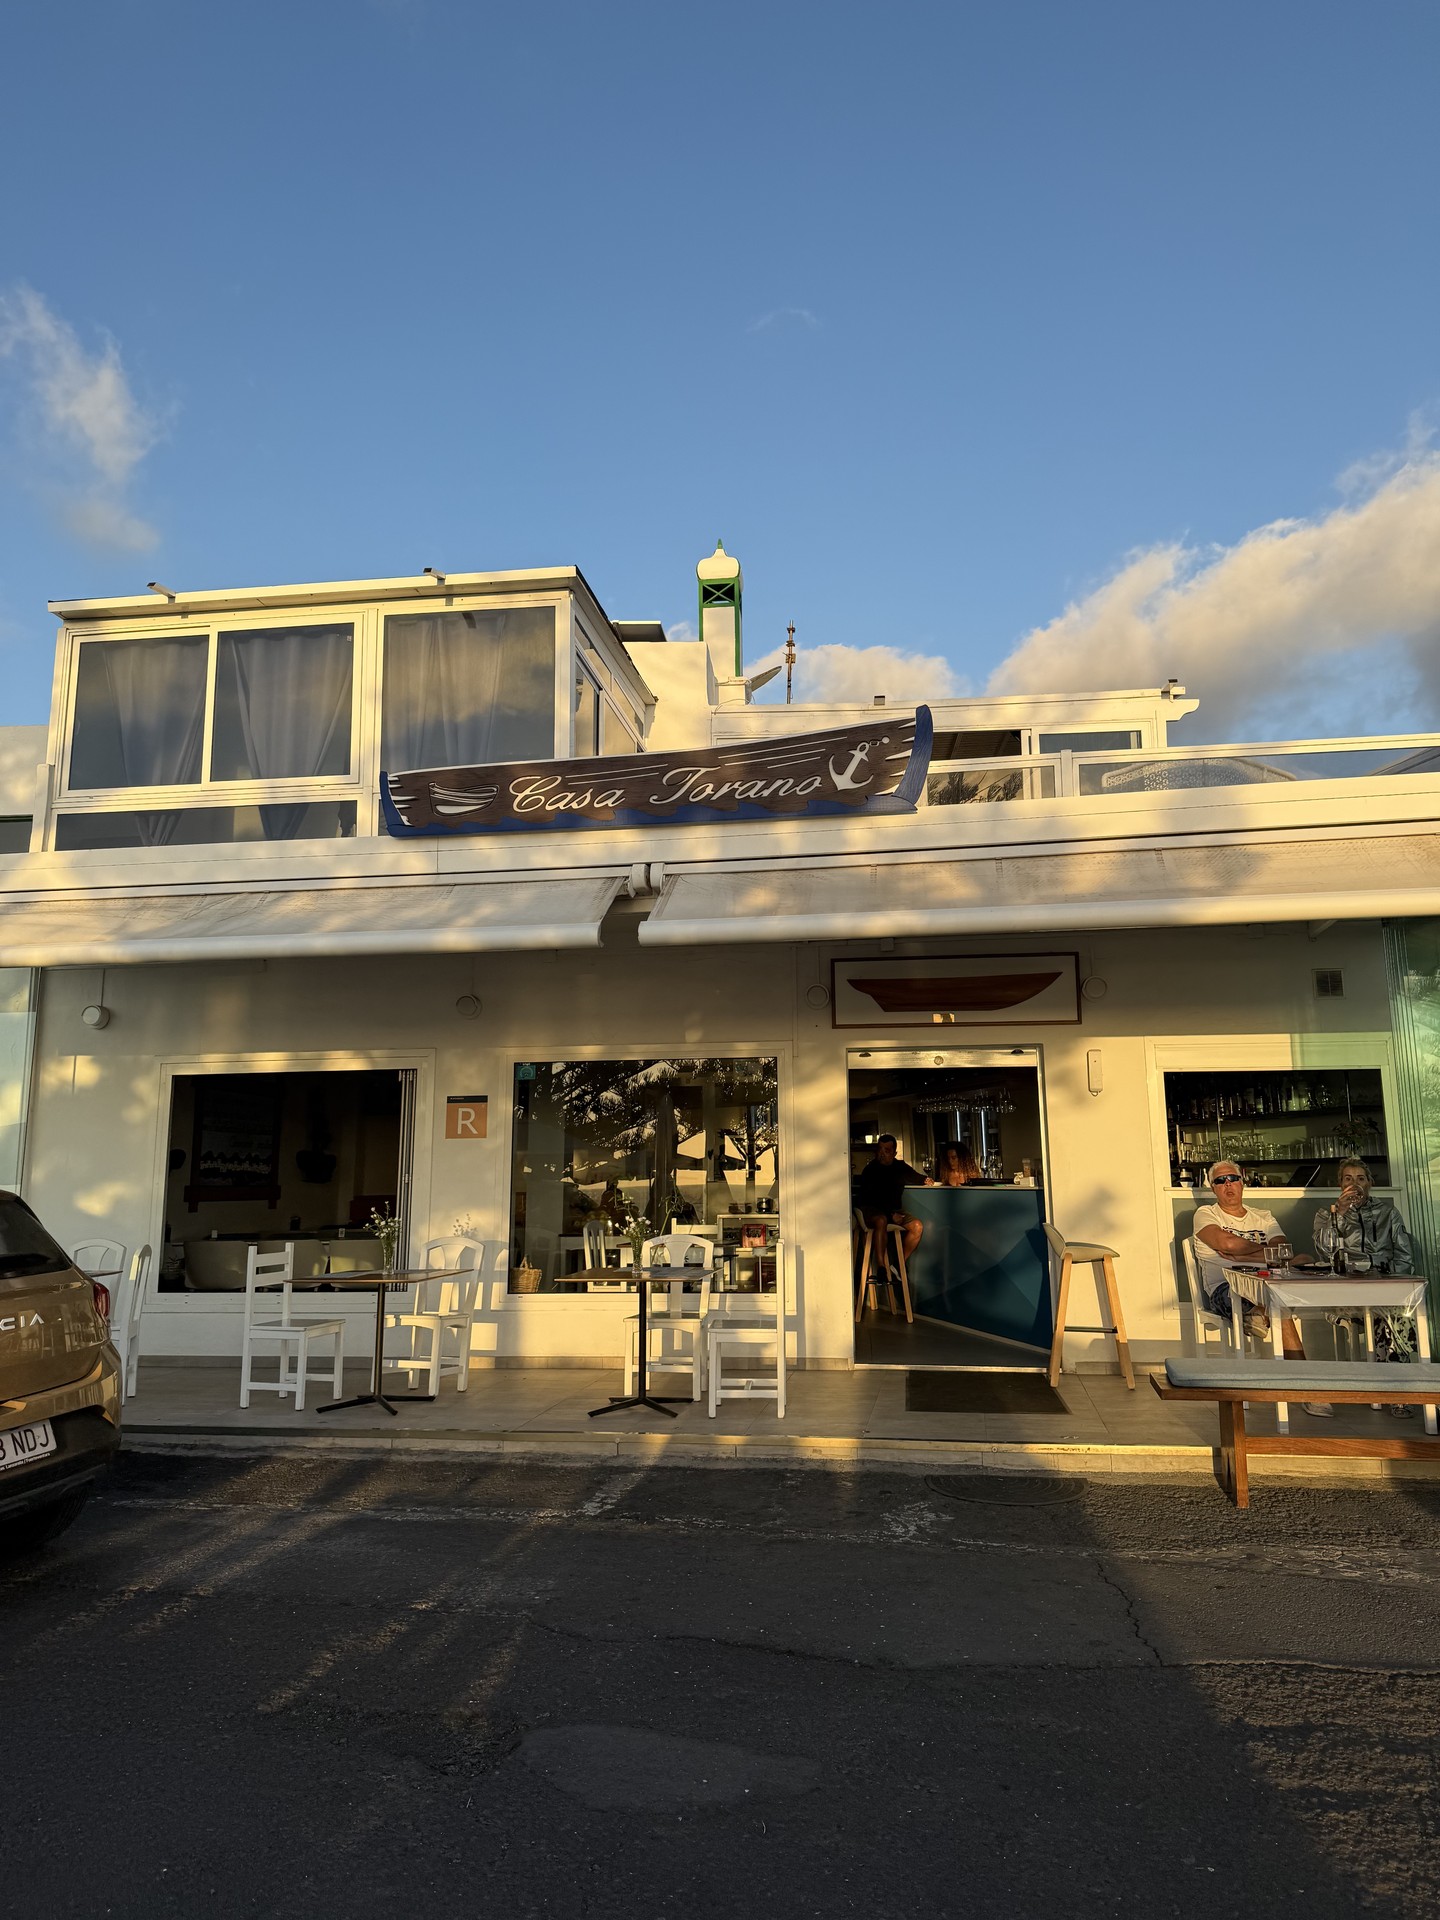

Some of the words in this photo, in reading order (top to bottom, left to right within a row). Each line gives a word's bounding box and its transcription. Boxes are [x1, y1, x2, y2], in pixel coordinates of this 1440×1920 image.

[509, 775, 626, 813] Casa
[648, 765, 823, 804] Torano
[457, 1107, 479, 1135] R
[10, 1423, 49, 1456] NDJ
